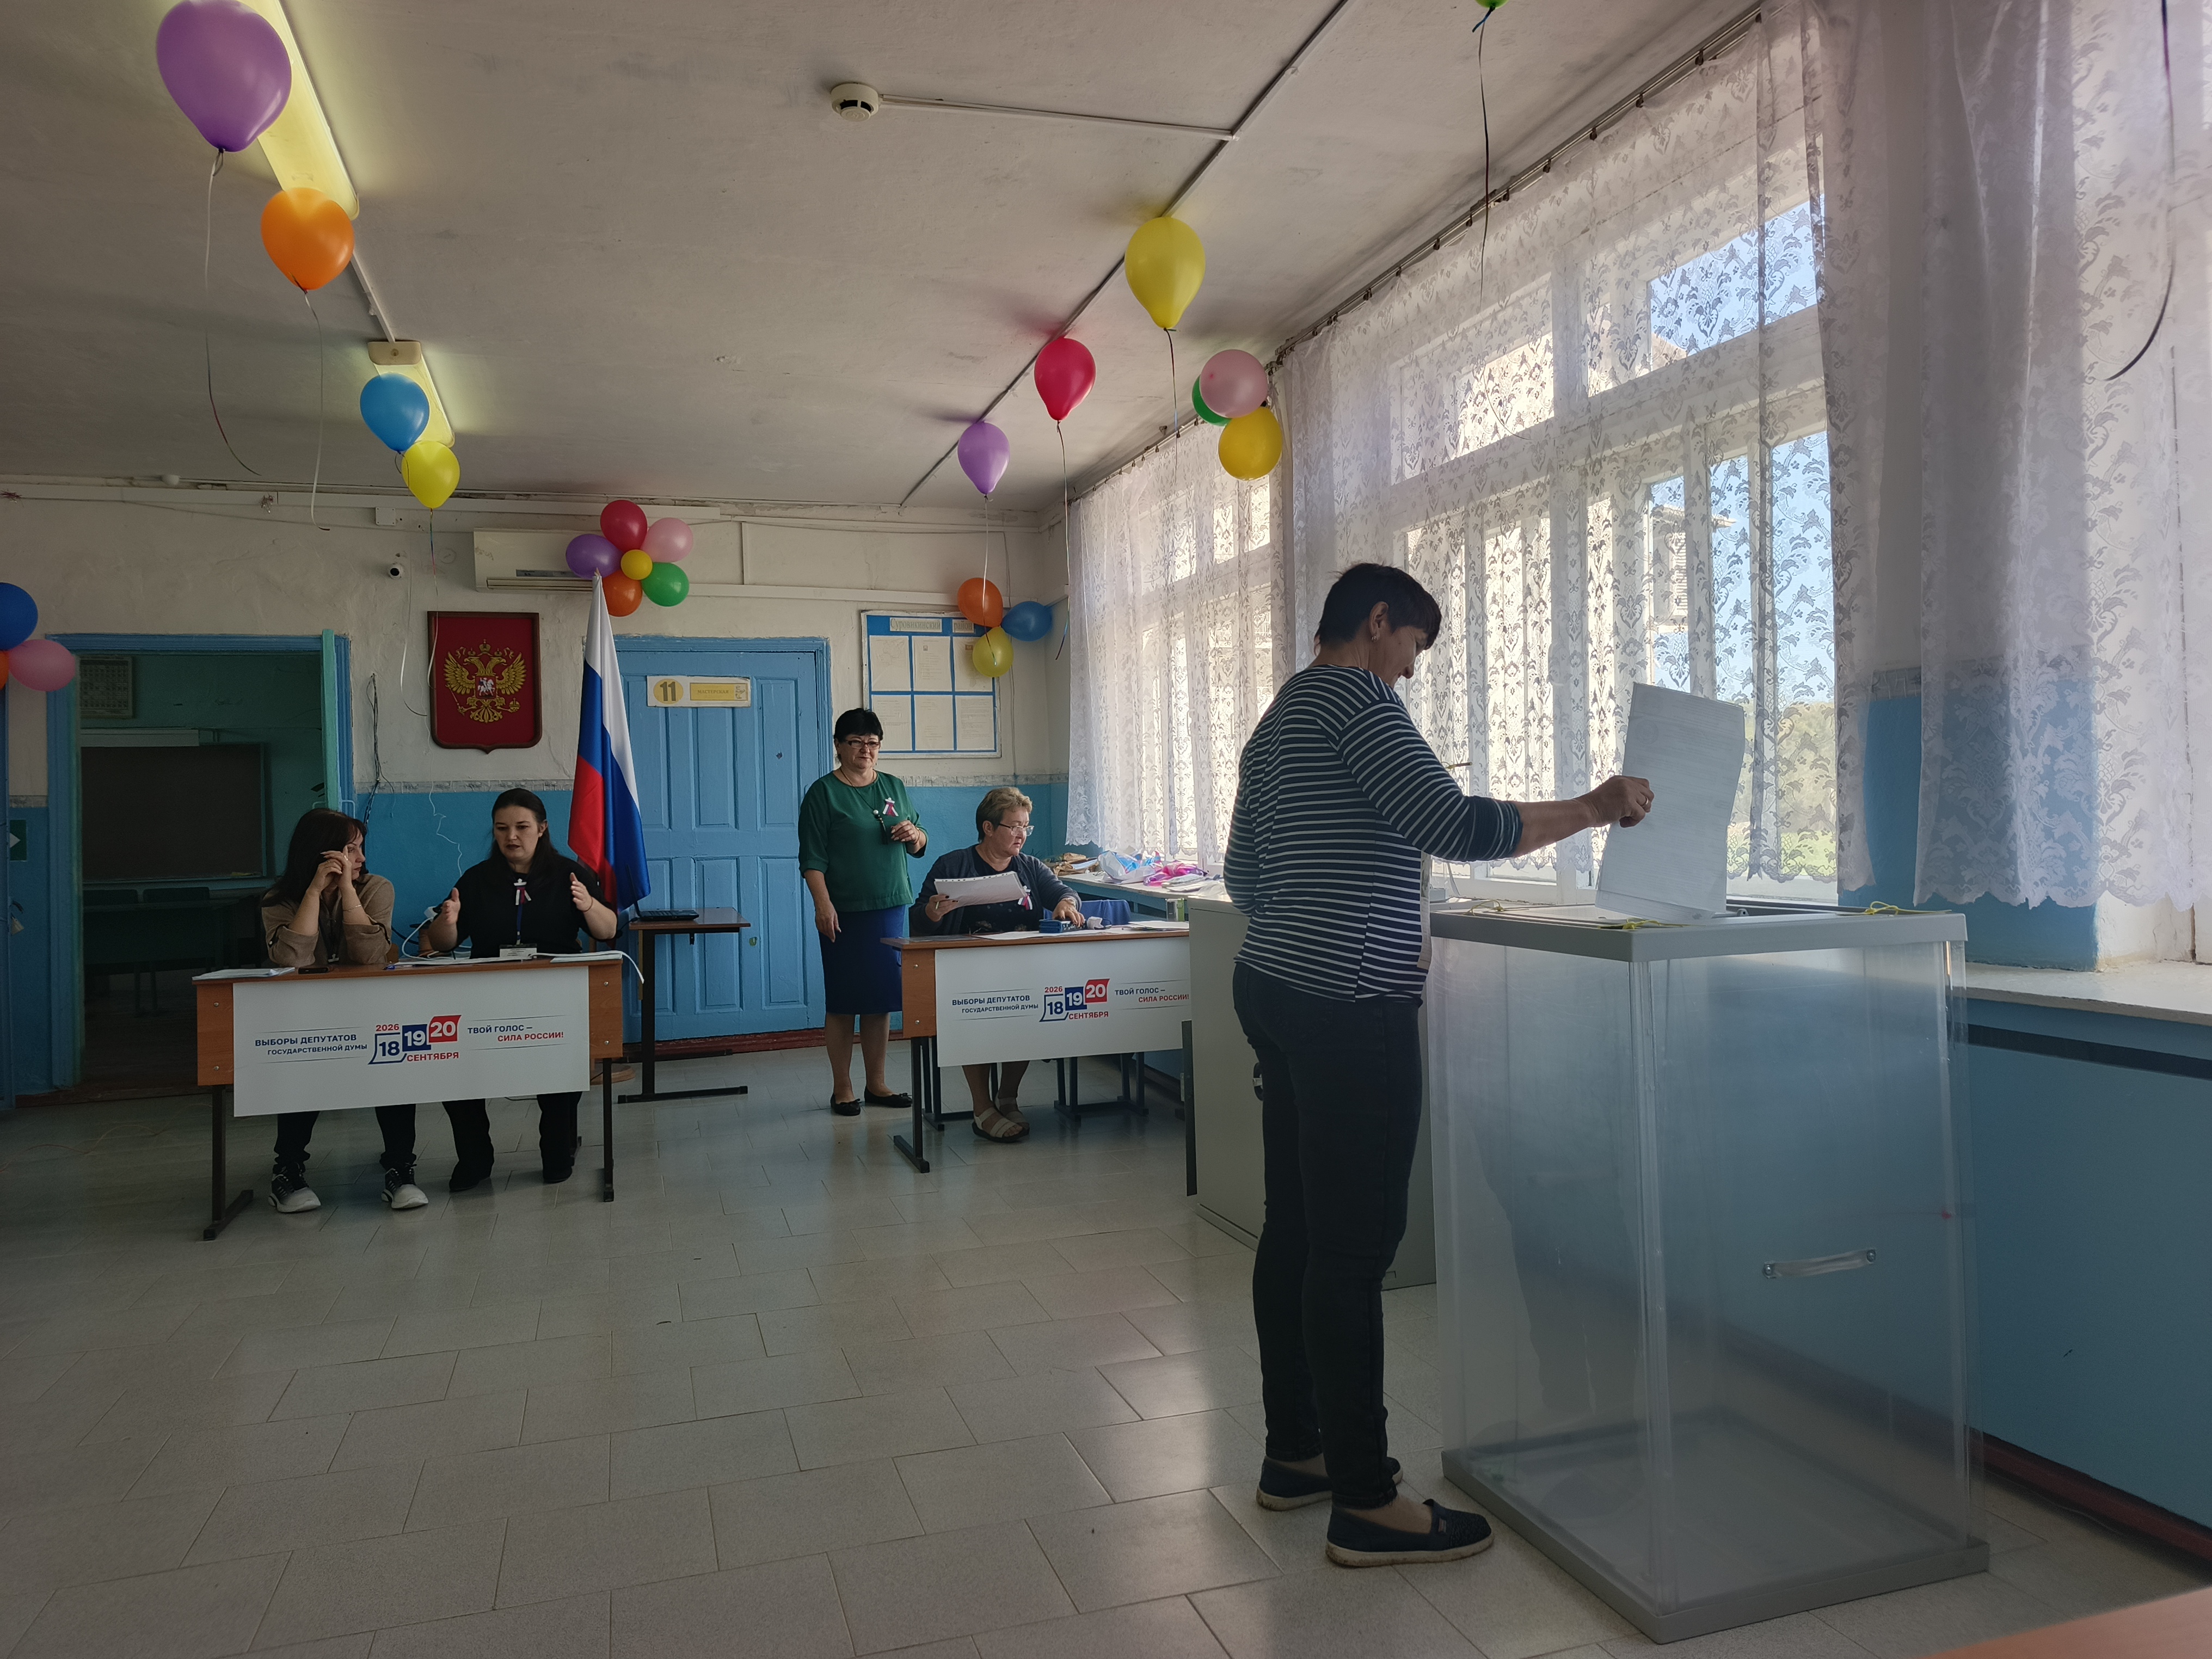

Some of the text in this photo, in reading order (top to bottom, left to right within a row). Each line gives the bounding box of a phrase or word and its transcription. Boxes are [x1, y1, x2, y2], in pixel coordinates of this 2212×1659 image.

[890, 618, 973, 632] Суровикинский район
[660, 681, 677, 702] 11
[1086, 984, 1106, 998] 20
[1115, 987, 1134, 996] ТВОЙ
[986, 995, 1030, 1004] ДЕПУТАТОВ
[1067, 992, 1083, 1006] 19
[962, 1004, 1019, 1013] ГОСУДАРСТВЕННОЙ
[1047, 1001, 1064, 1015] 18
[1068, 1011, 1109, 1019] СЕНТЯБРЯ
[431, 1021, 456, 1037] 20
[468, 1025, 491, 1034] ТВОЙ
[255, 1034, 357, 1046] ВЫБОРЫ ДЕПУТАТОВ
[404, 1030, 426, 1046] 19
[525, 1031, 564, 1040] РОССИИ!
[267, 1044, 343, 1055] ГОСУДАРСТВЕННОЙ
[379, 1041, 400, 1056] 18
[407, 1052, 459, 1061] СЕНТЯБРЯ
